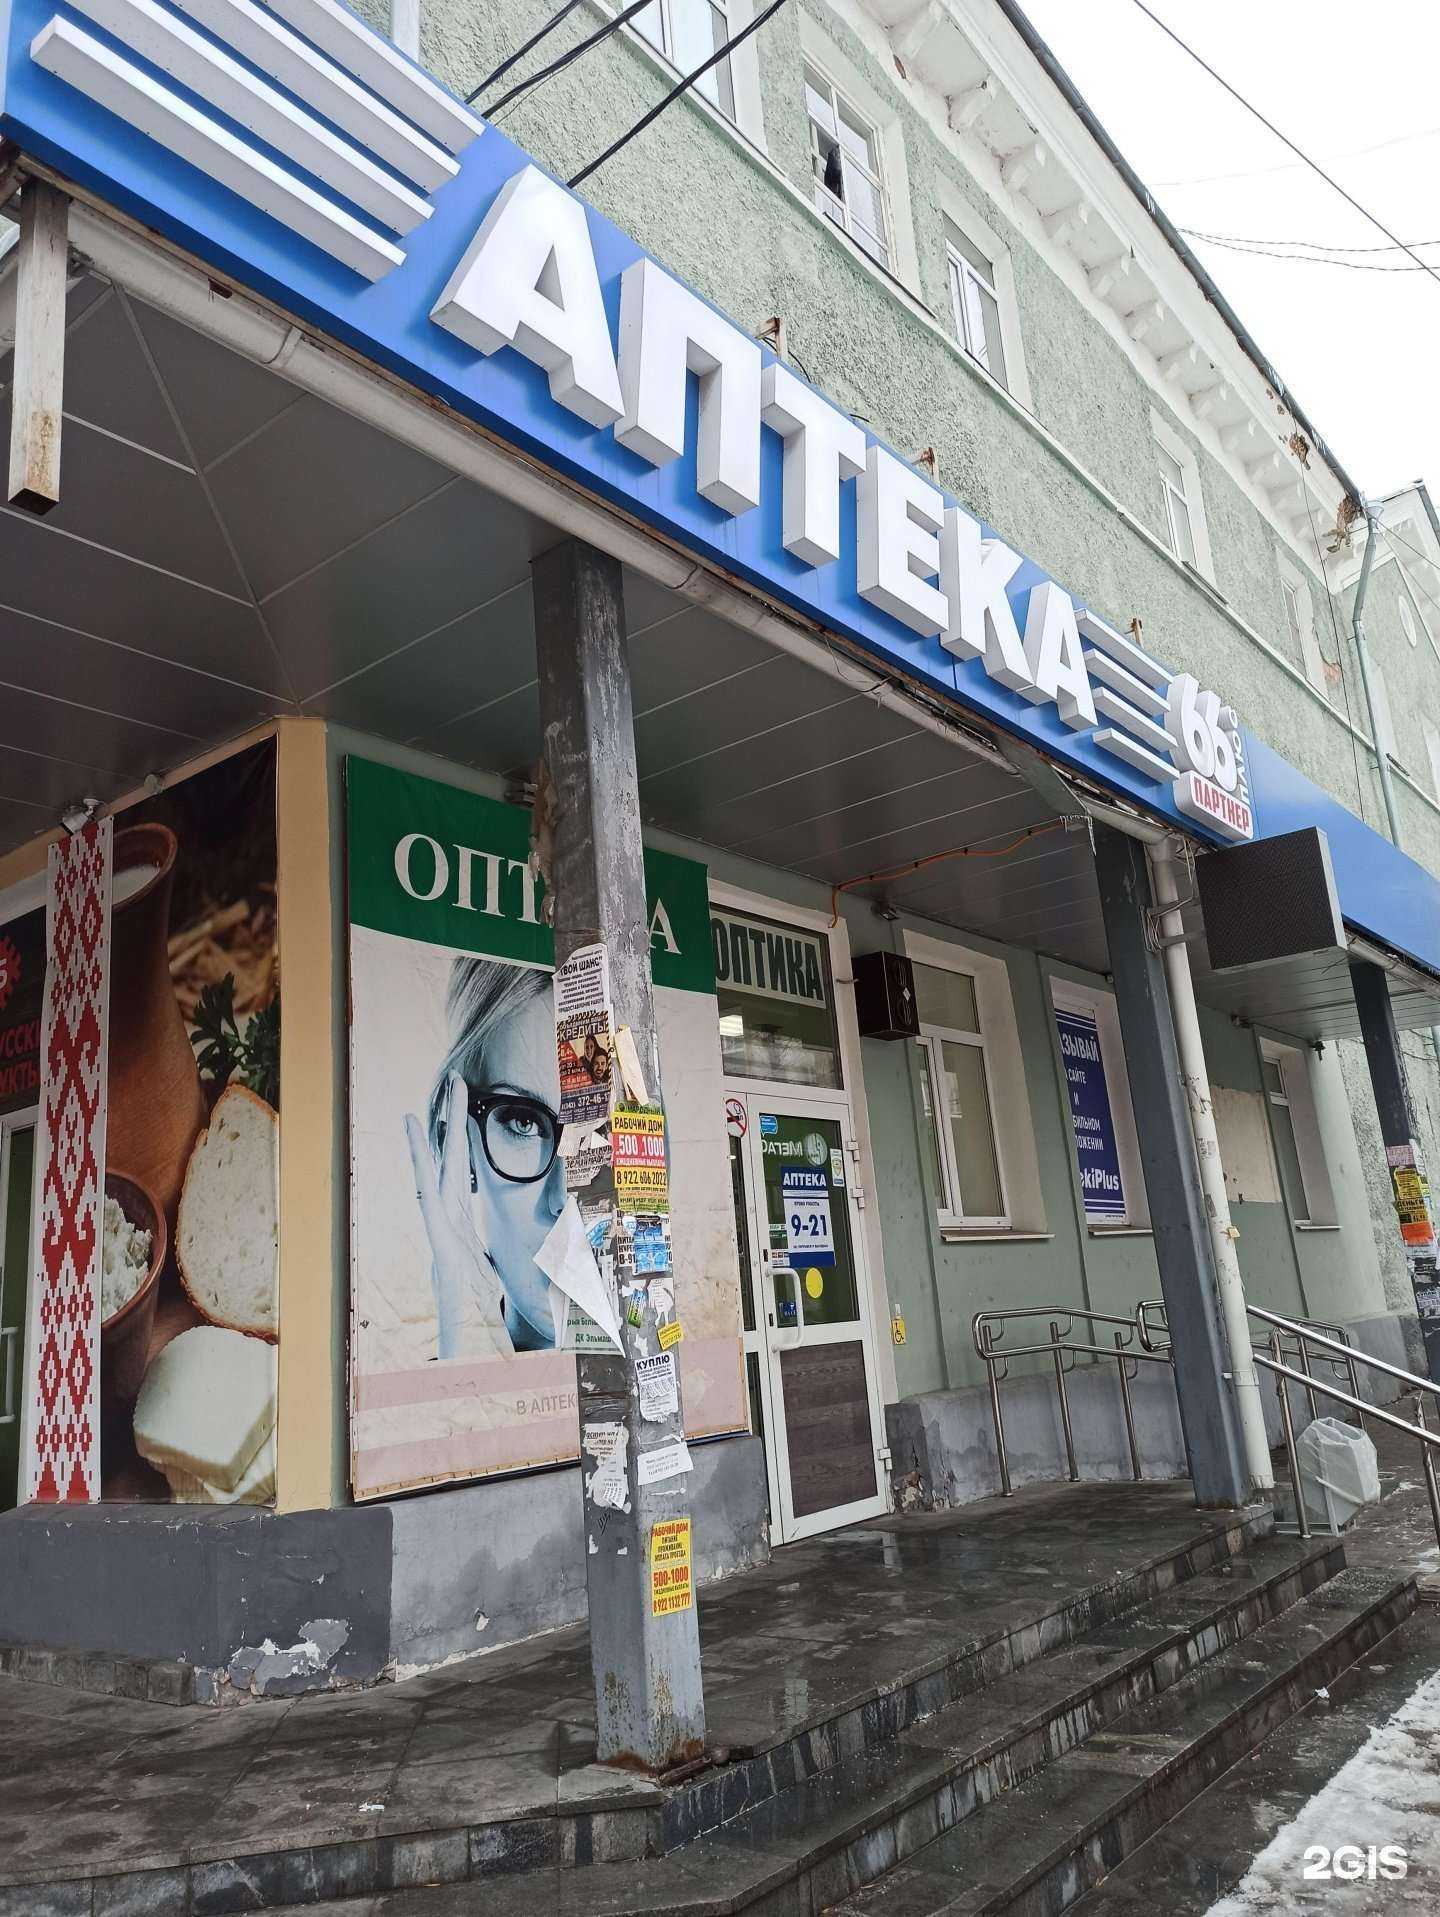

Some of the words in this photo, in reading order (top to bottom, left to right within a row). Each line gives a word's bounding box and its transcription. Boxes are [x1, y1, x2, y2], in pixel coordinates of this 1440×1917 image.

[430, 164, 1098, 730] АПТЕКА
[1165, 673, 1238, 792] 66
[1193, 777, 1250, 832] ПАРТНЕР
[394, 833, 682, 955] ОПТА
[712, 917, 824, 1001] ОПТИКА
[560, 1020, 606, 1041] КРЕДИТЫ
[1068, 1067, 1087, 1084] САЙТЕ
[614, 1116, 647, 1131] РАБОЧИЙ
[648, 1119, 663, 1133] ДОМ
[783, 1172, 827, 1187] АПТЕКА
[791, 1214, 828, 1237] 9-21
[637, 1355, 670, 1370] КУПЛЮ
[516, 1399, 527, 1415] В
[531, 1392, 575, 1414] АПТЕК
[653, 1565, 689, 1587] 500-1000
